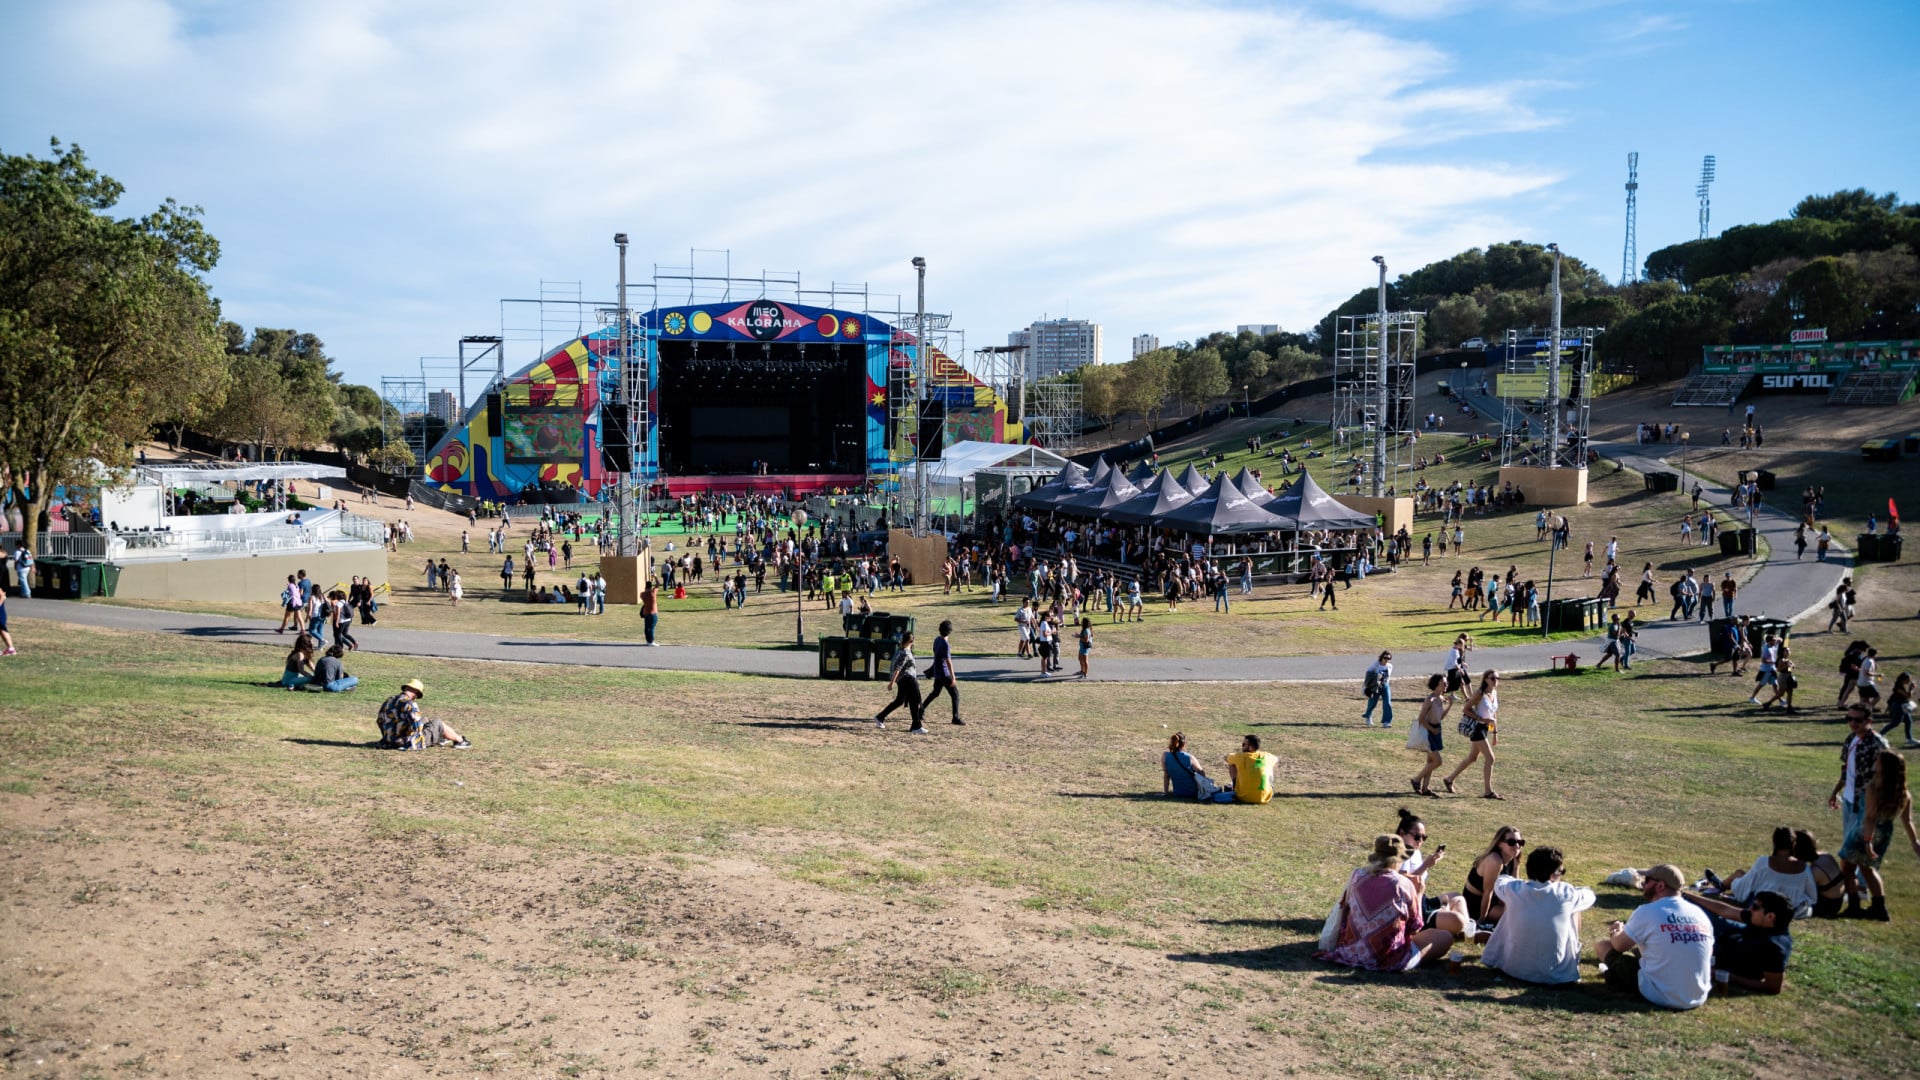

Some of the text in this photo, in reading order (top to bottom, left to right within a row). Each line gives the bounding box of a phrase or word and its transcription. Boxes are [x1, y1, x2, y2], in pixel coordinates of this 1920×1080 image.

[753, 307, 779, 317] MEO
[728, 317, 802, 328] KALORAMA
[1792, 330, 1825, 341] SUMOL
[1762, 375, 1834, 388] SUMOL
[1670, 932, 1708, 944] japan
